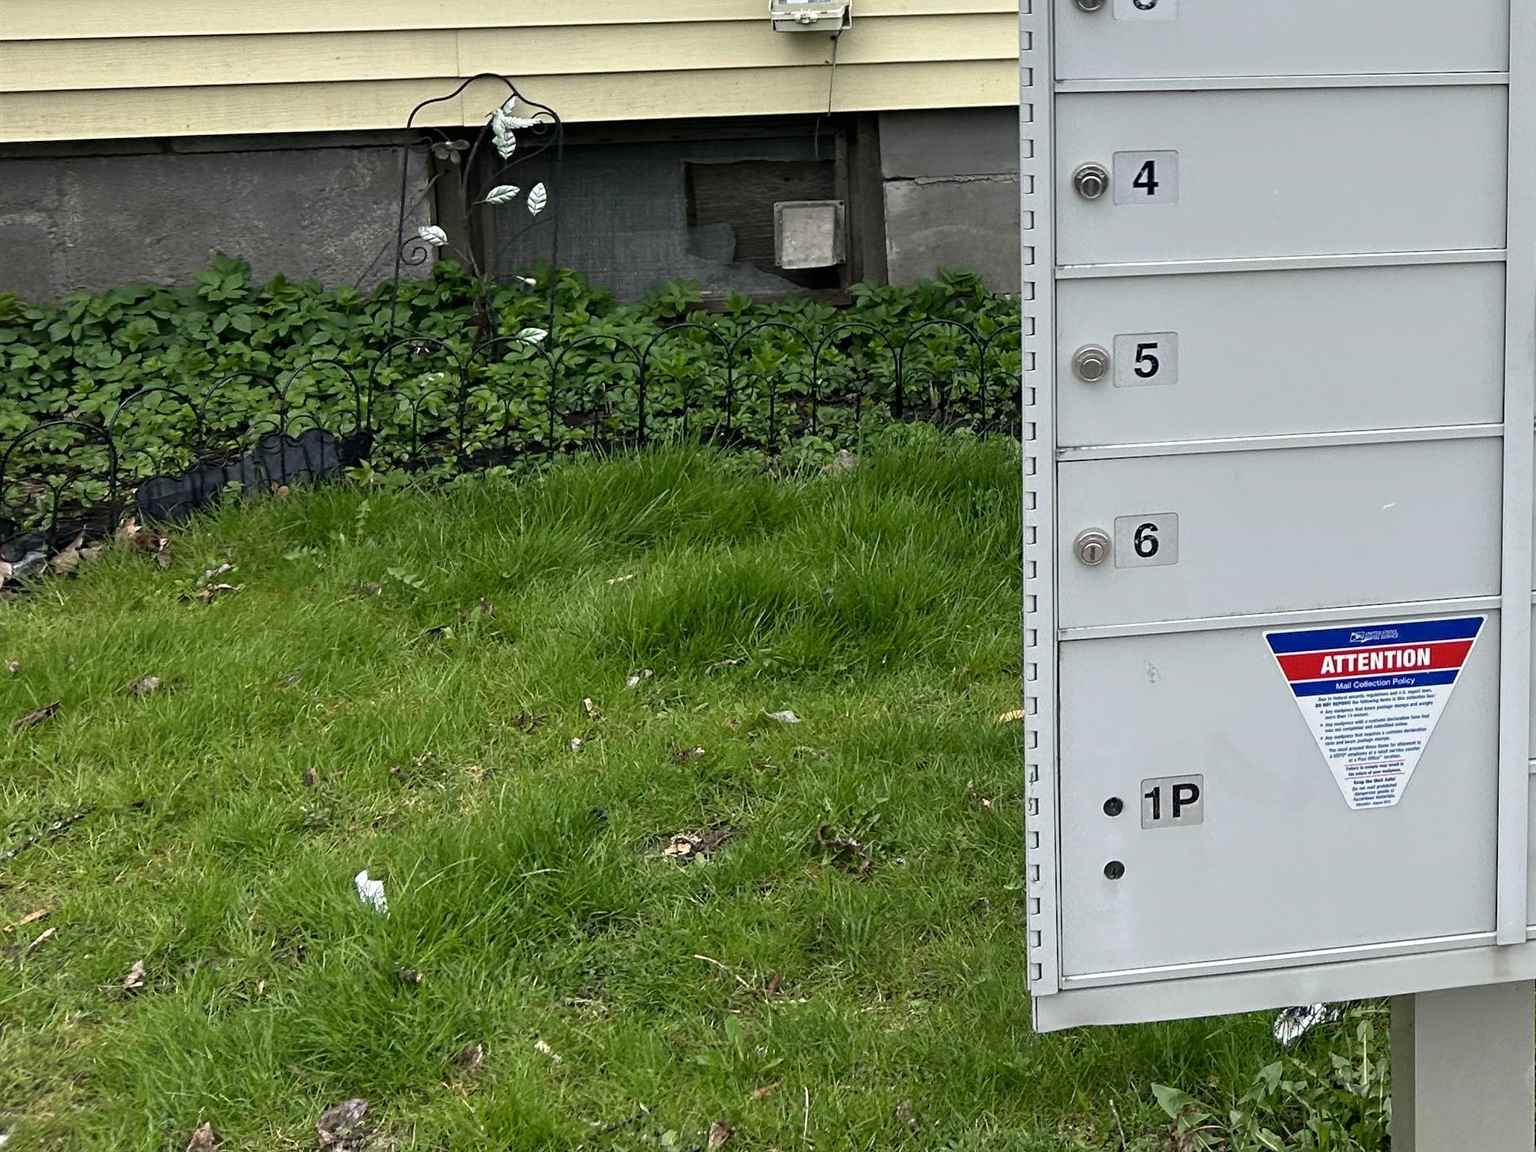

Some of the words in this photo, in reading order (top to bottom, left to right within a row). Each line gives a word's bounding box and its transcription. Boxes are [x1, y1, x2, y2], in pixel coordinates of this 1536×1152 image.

[1132, 160, 1159, 196] 4
[1133, 342, 1160, 379] 5
[1133, 522, 1159, 558] 6
[1320, 647, 1431, 675] ATTENTION
[1335, 682, 1352, 690] Mail
[1353, 678, 1391, 689] Collection
[1392, 676, 1416, 686] Policy
[1144, 783, 1201, 821] 1P
